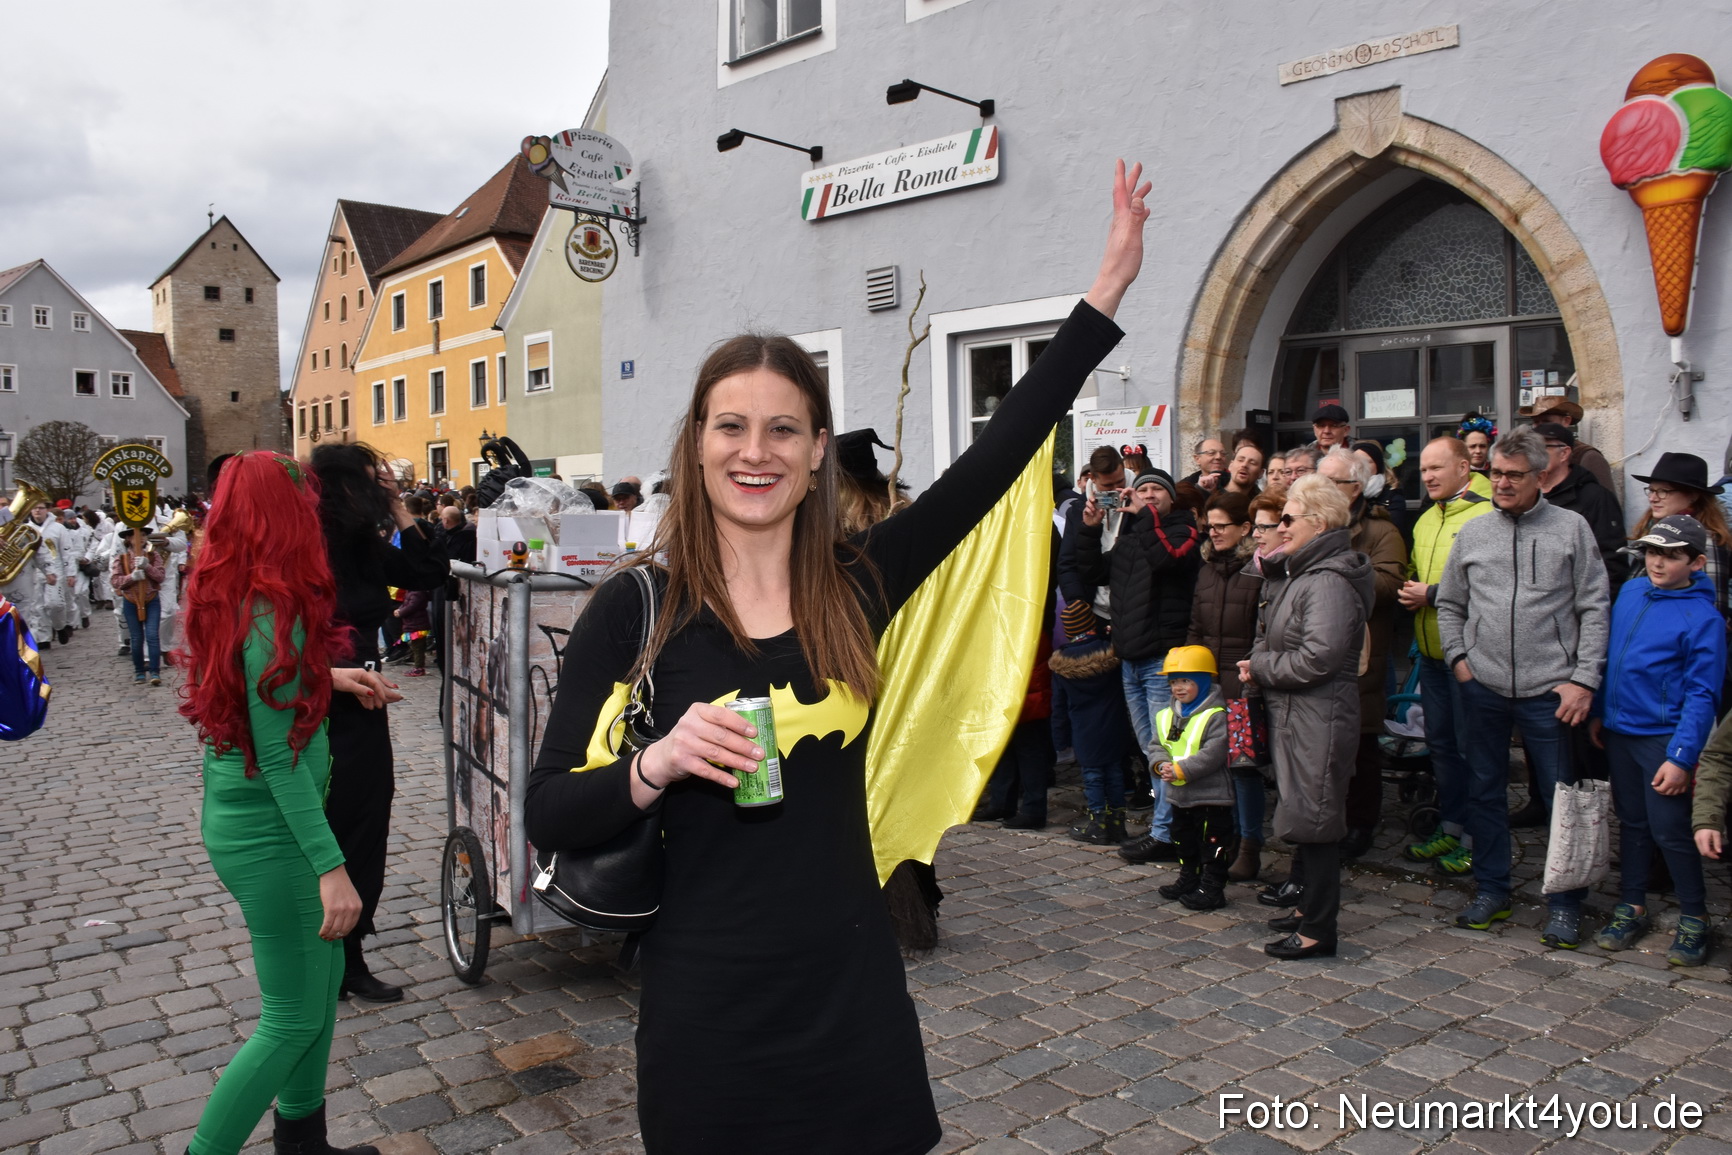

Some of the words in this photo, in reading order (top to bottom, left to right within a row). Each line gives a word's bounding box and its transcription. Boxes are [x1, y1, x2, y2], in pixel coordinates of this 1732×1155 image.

[570, 131, 613, 150] Pizzeria
[581, 150, 604, 163] Café
[838, 161, 875, 177] Pizzeria
[884, 152, 908, 166] Café
[917, 140, 957, 158] Eisdiele
[568, 161, 614, 181] Eisdiele
[831, 177, 885, 208] Bella
[891, 165, 958, 194] Roma
[555, 193, 590, 205] Roma
[577, 189, 608, 202] Bella
[1084, 419, 1114, 428] Bella
[1095, 427, 1128, 435] Roma
[96, 449, 169, 477] Blaskapelle
[111, 464, 157, 482] Pilsach
[126, 478, 144, 486] 1954
[580, 568, 586, 576] 5
